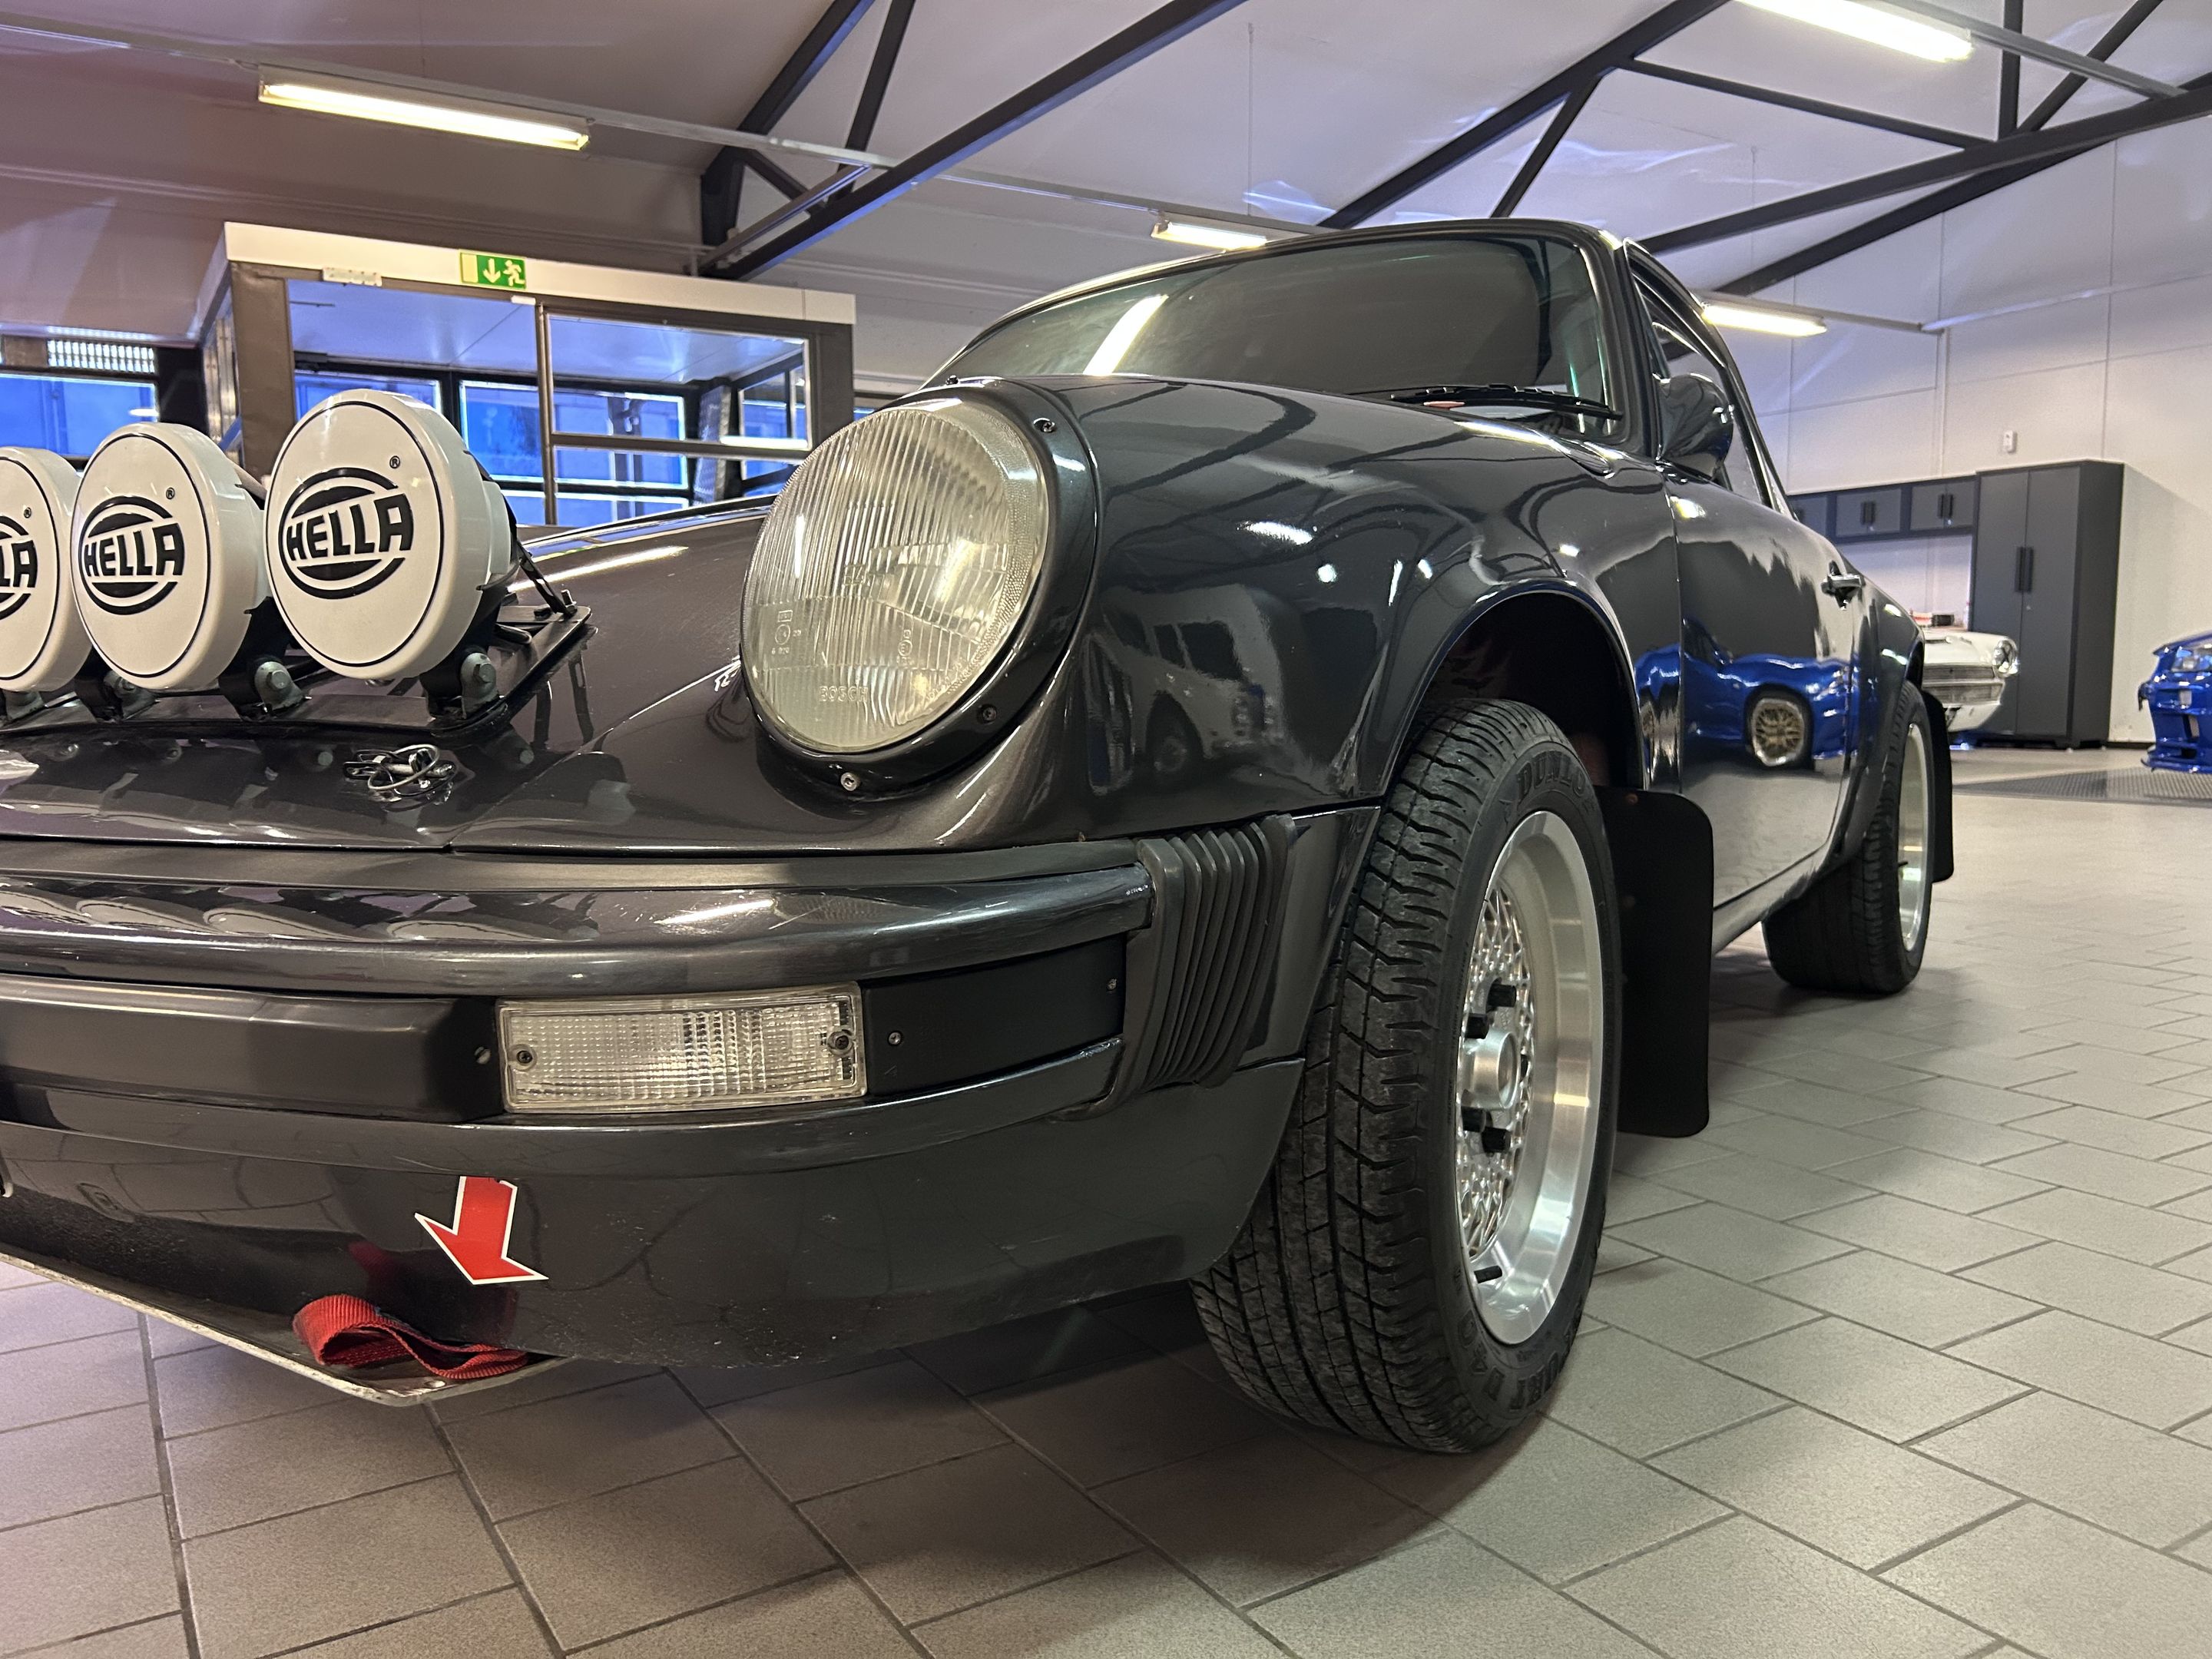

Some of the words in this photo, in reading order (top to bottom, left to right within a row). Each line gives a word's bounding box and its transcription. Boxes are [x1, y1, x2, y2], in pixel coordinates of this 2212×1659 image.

[84, 523, 184, 577] HELLA
[286, 493, 414, 561] HELLA
[819, 685, 869, 702] BOSCH
